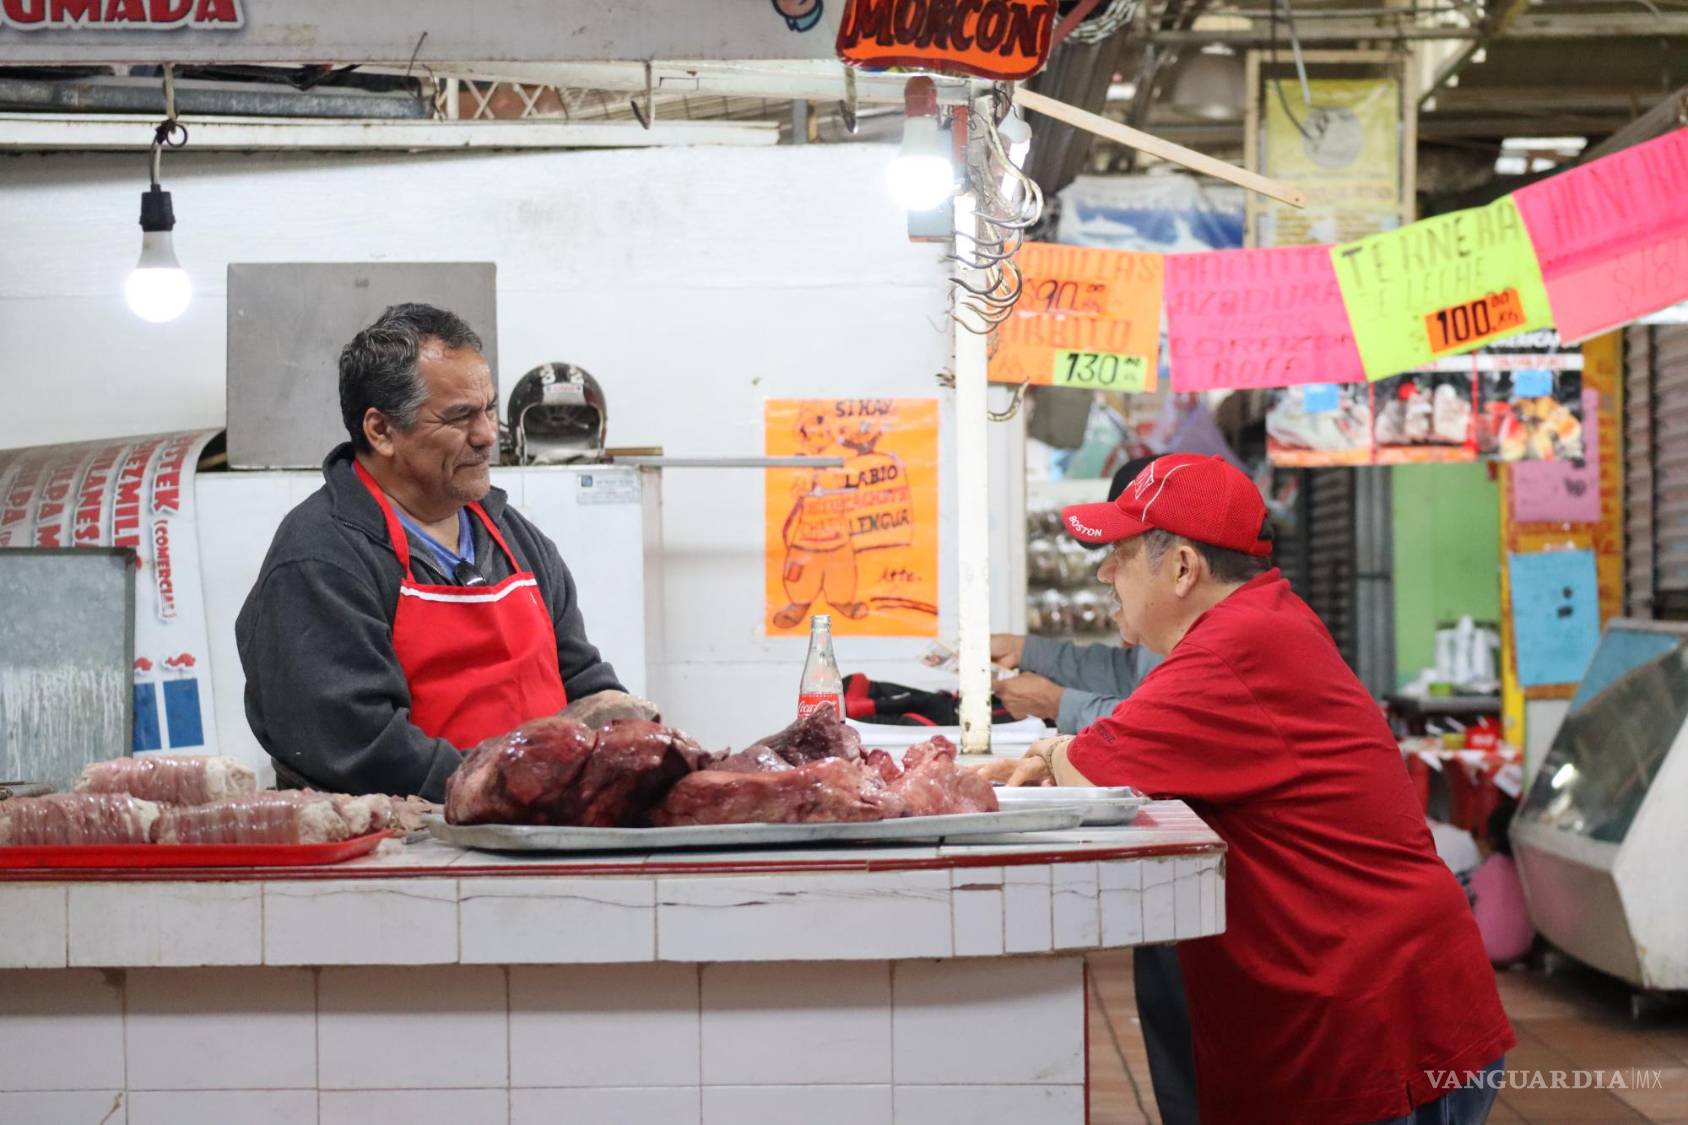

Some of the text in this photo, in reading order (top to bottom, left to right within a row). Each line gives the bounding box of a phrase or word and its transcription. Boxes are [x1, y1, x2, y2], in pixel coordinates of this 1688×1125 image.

[844, 465, 898, 489] LABIO
[848, 508, 911, 537] LENGUA
[1068, 514, 1103, 537] BOSTON
